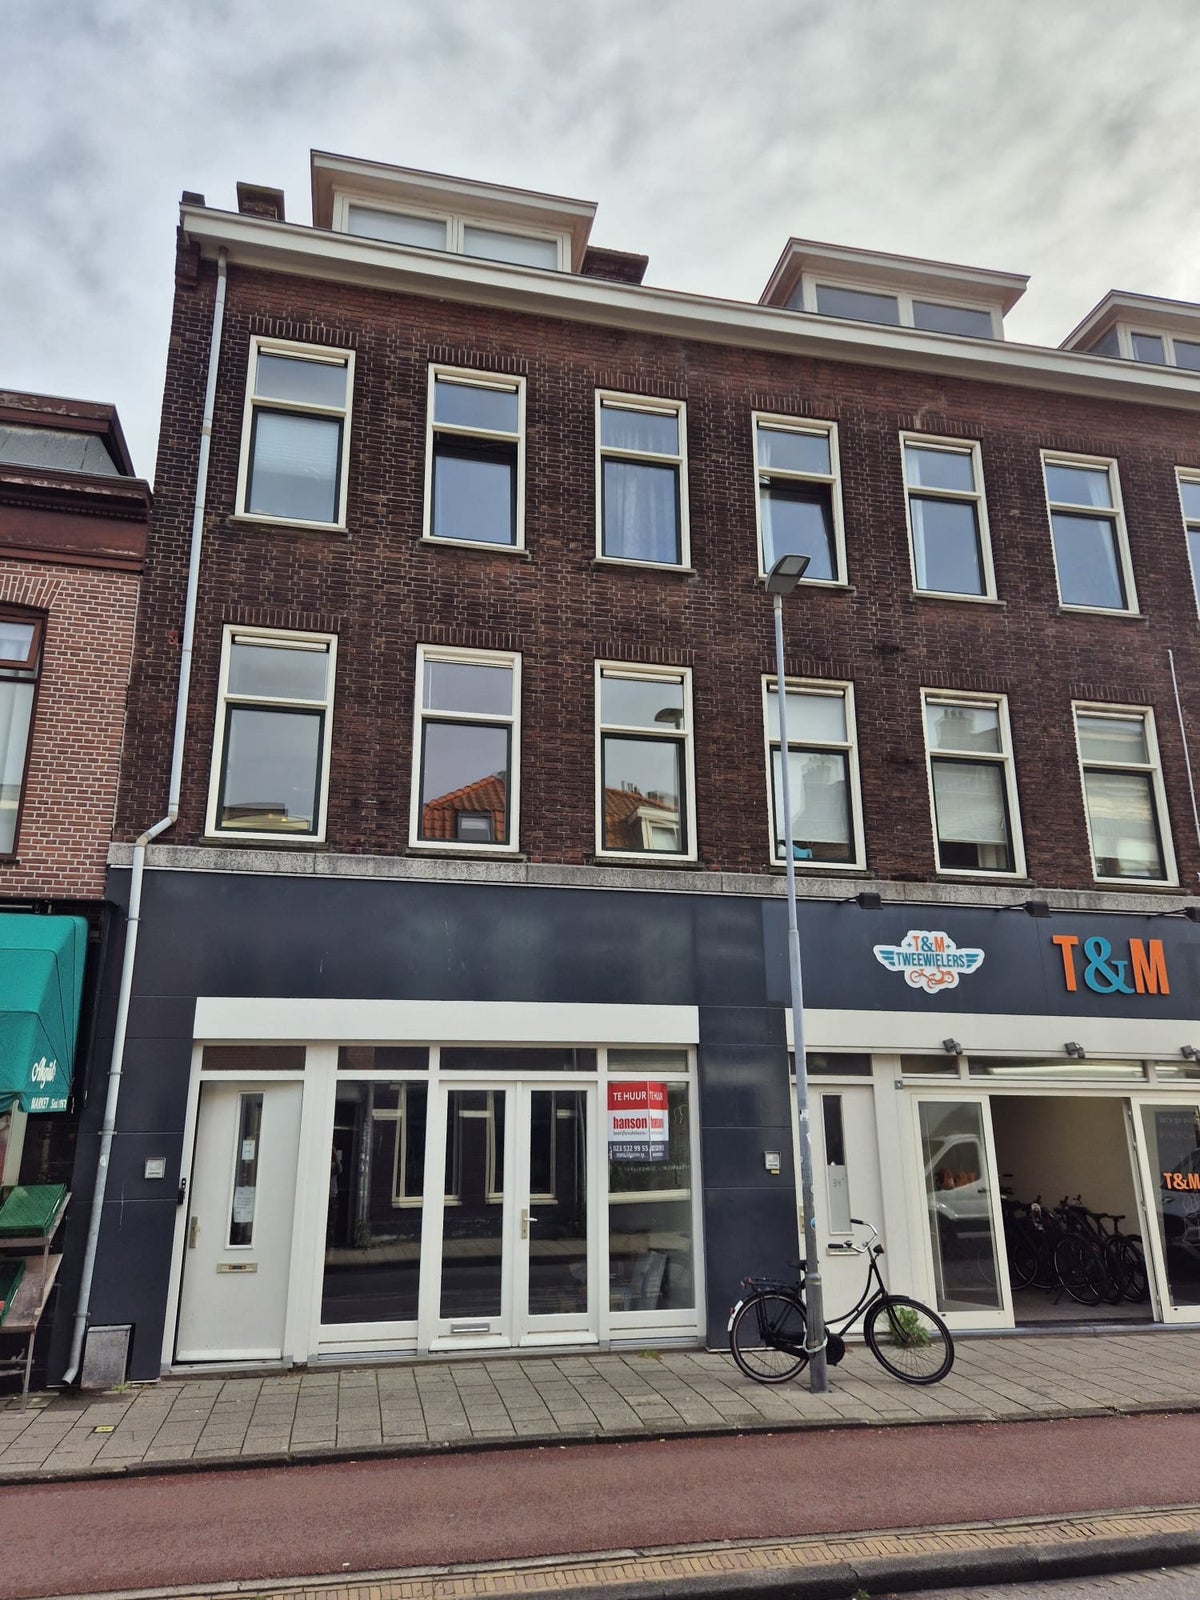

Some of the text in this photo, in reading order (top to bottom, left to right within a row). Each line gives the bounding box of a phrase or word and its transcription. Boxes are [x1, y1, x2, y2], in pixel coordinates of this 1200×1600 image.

[912, 935, 945, 953] T&M
[895, 951, 966, 969] TWEEWIELERS
[1052, 934, 1170, 995] T&M
[613, 1091, 647, 1101] TE HUUR
[613, 1117, 647, 1130] hanson
[1163, 1172, 1200, 1190] T&M
